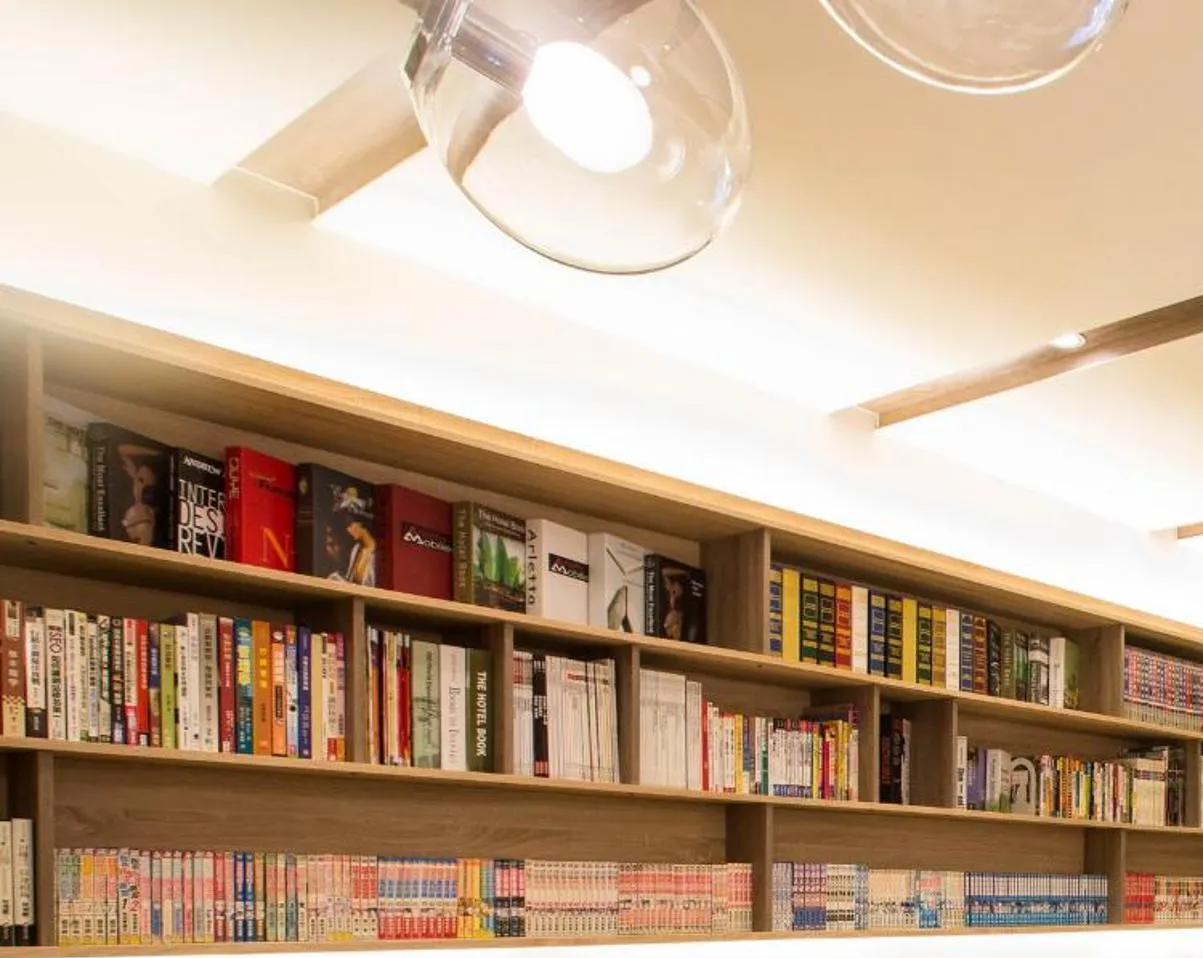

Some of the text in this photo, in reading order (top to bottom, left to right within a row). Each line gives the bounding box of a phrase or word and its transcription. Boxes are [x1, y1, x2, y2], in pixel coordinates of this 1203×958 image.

[476, 671, 487, 757] THE HOTEL BOOK
